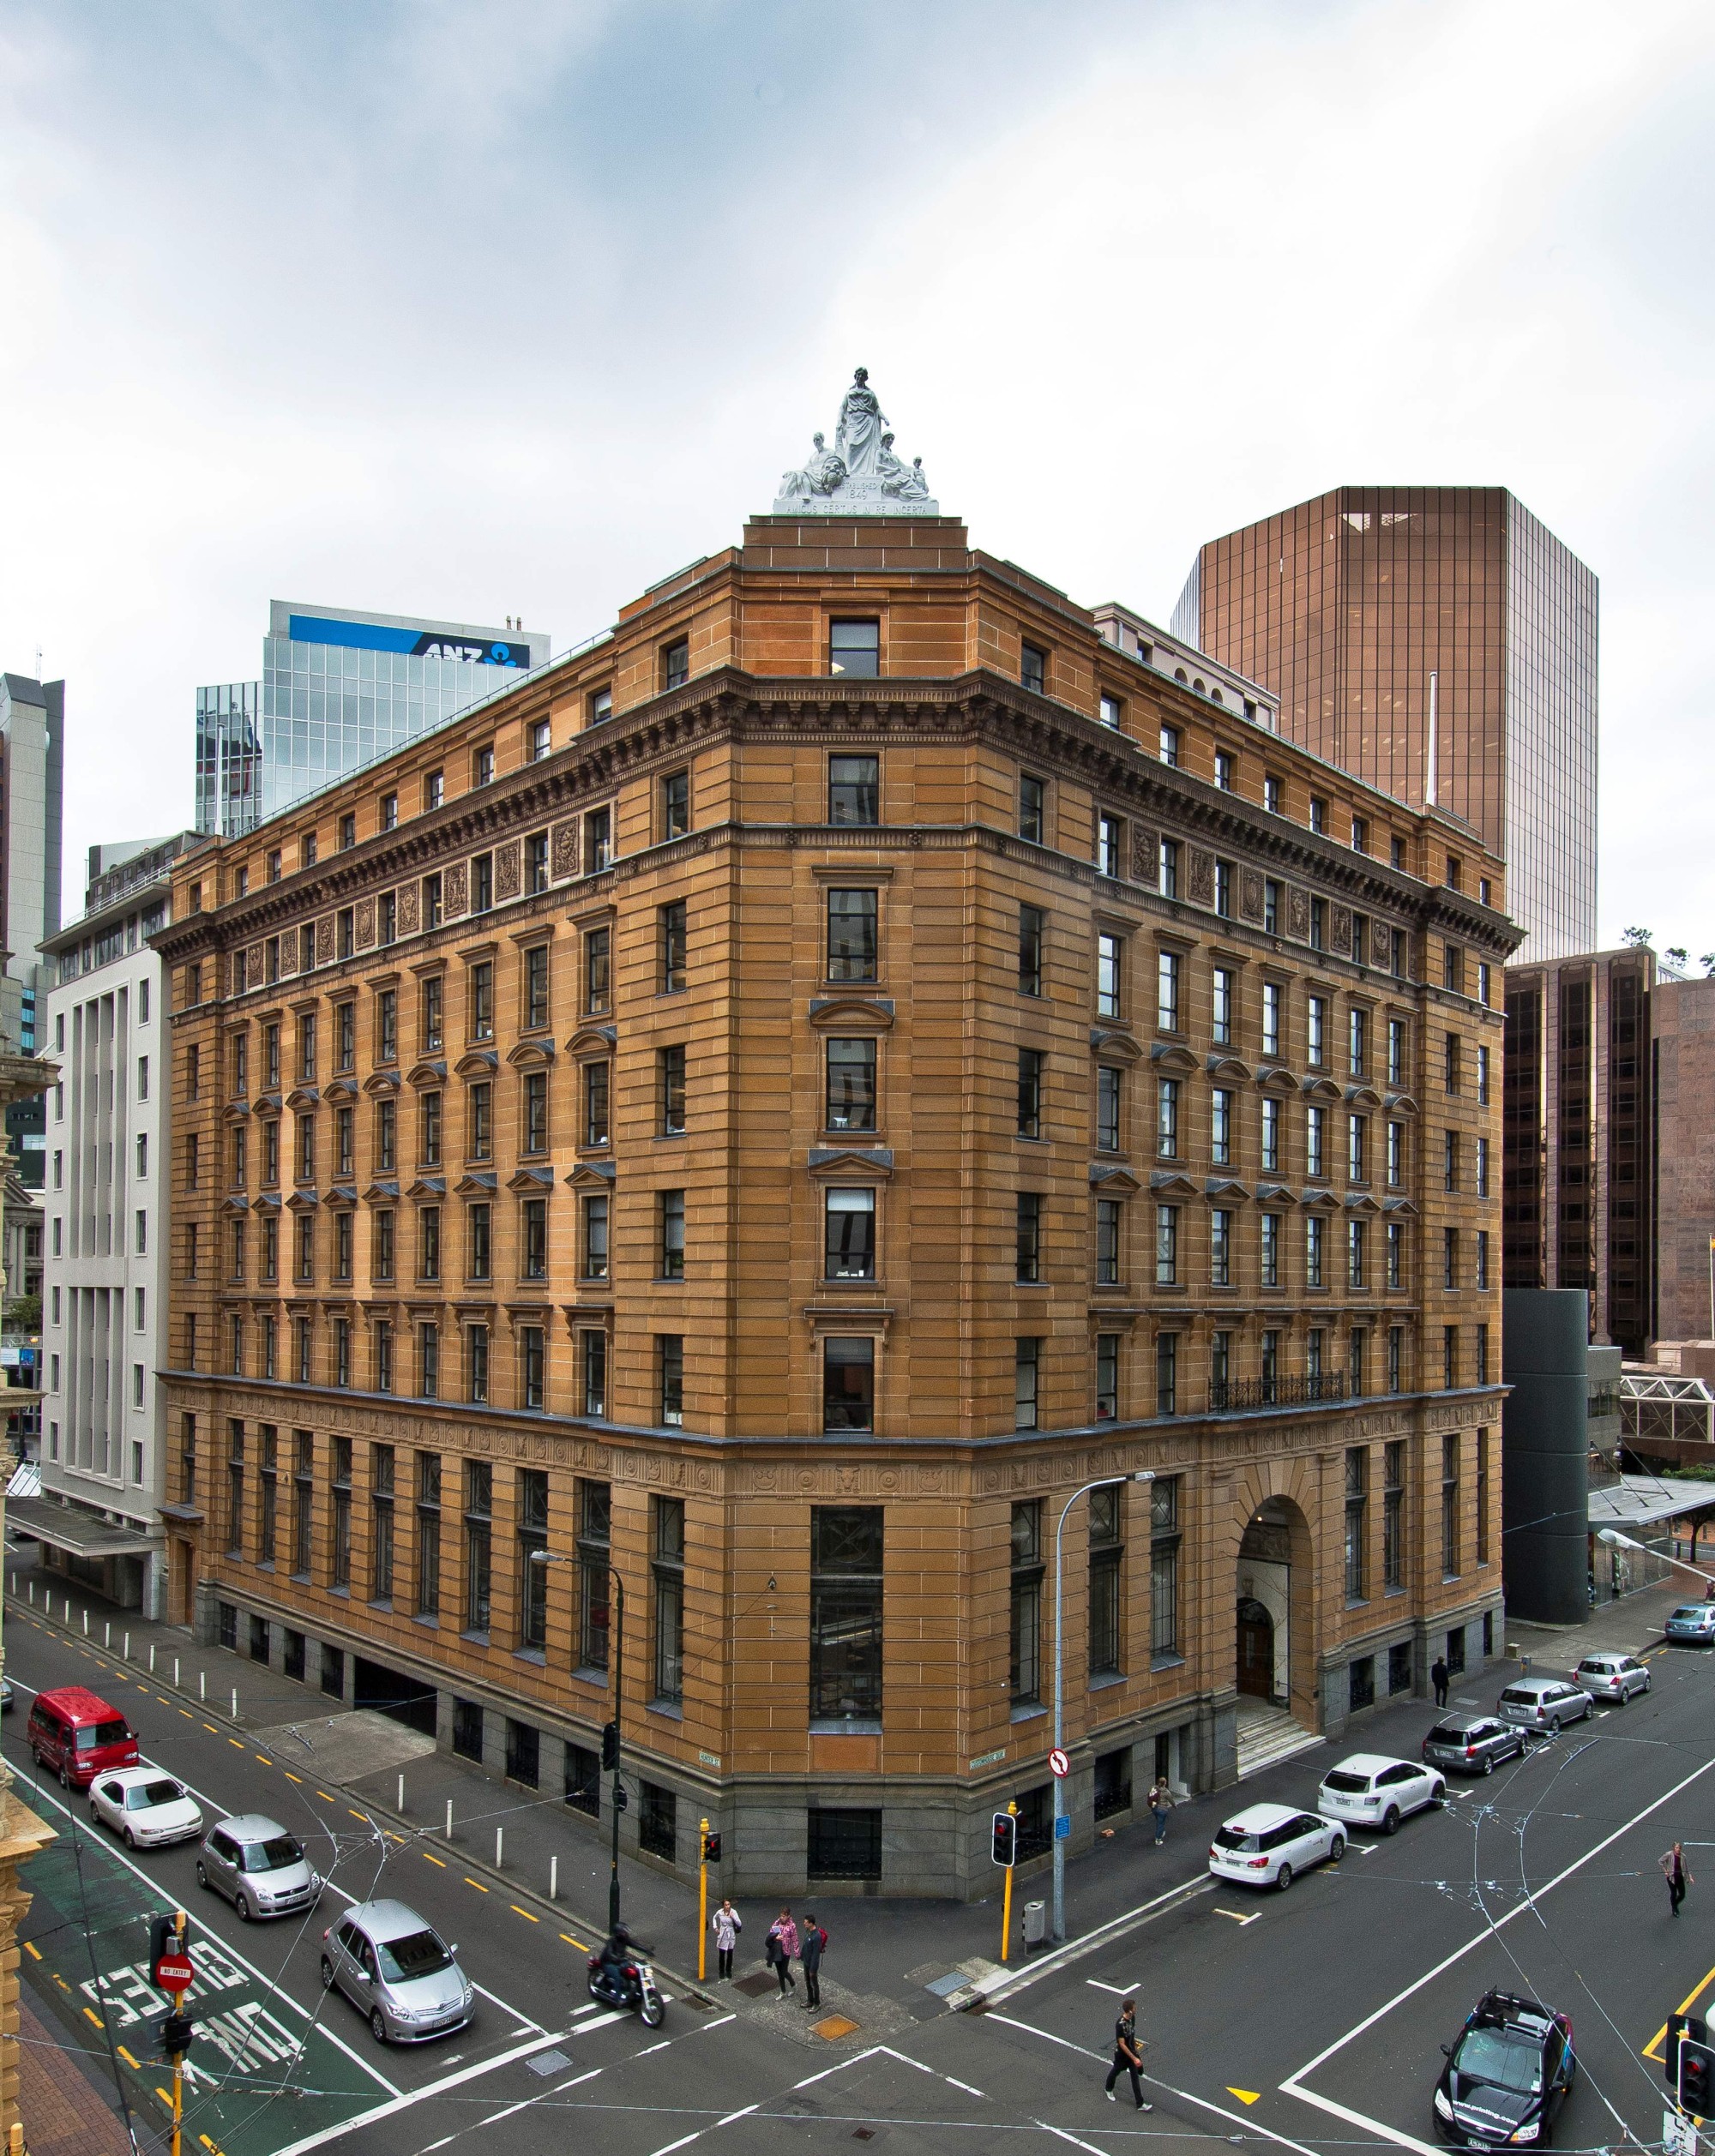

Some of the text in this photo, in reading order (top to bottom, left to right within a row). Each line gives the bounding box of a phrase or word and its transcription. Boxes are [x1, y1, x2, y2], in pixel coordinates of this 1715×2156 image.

[845, 489, 868, 501] 1849
[786, 505, 927, 515] AMICUS CERTUS IN RE INCERTA
[424, 643, 483, 663] ANZ
[1452, 2099, 1519, 2127] www.printing.com
